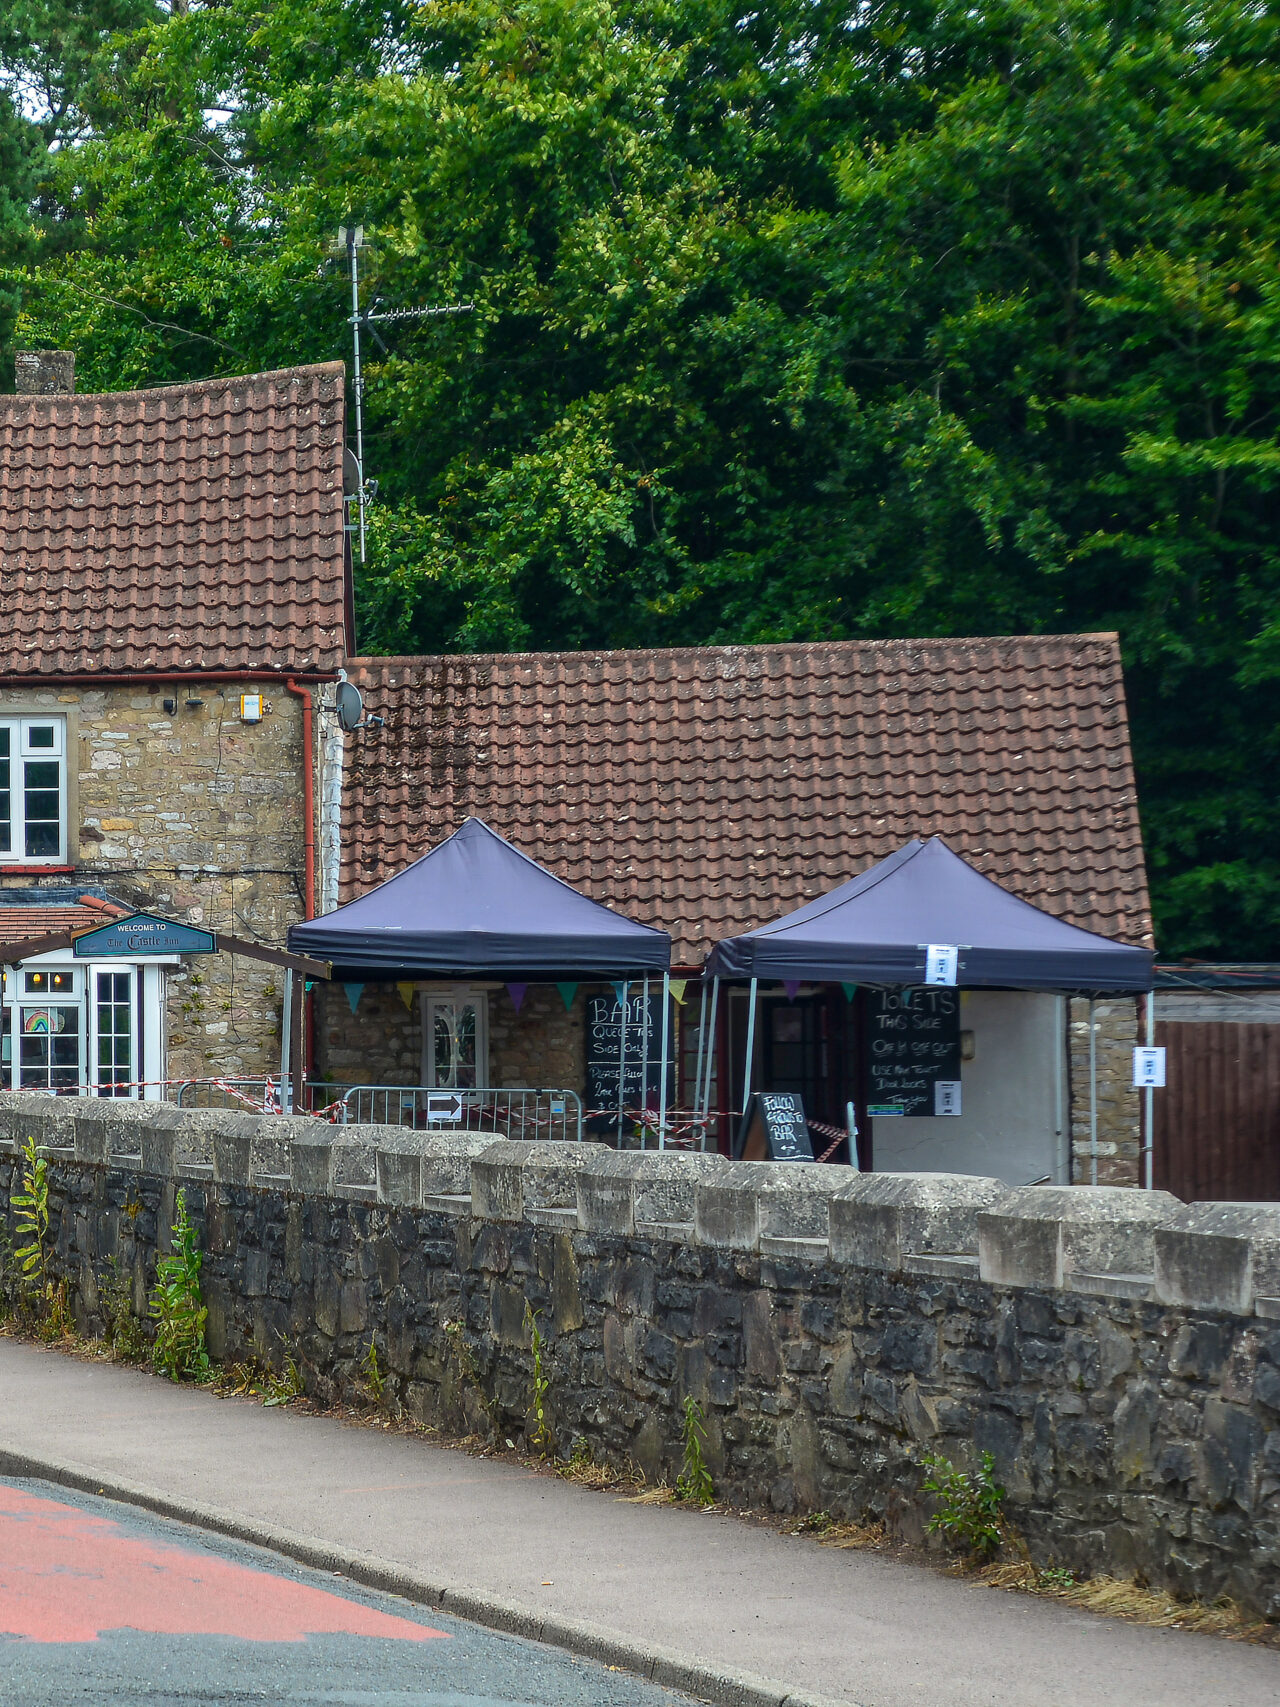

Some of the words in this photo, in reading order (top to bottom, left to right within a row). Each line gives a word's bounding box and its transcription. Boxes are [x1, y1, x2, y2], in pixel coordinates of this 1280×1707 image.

[117, 924, 154, 932] WELCOME
[156, 923, 166, 931] TO
[107, 938, 122, 947] The
[127, 934, 160, 951] Castle
[163, 936, 179, 945] Inn
[589, 996, 652, 1024] BAR
[770, 1123, 797, 1142] BAR
